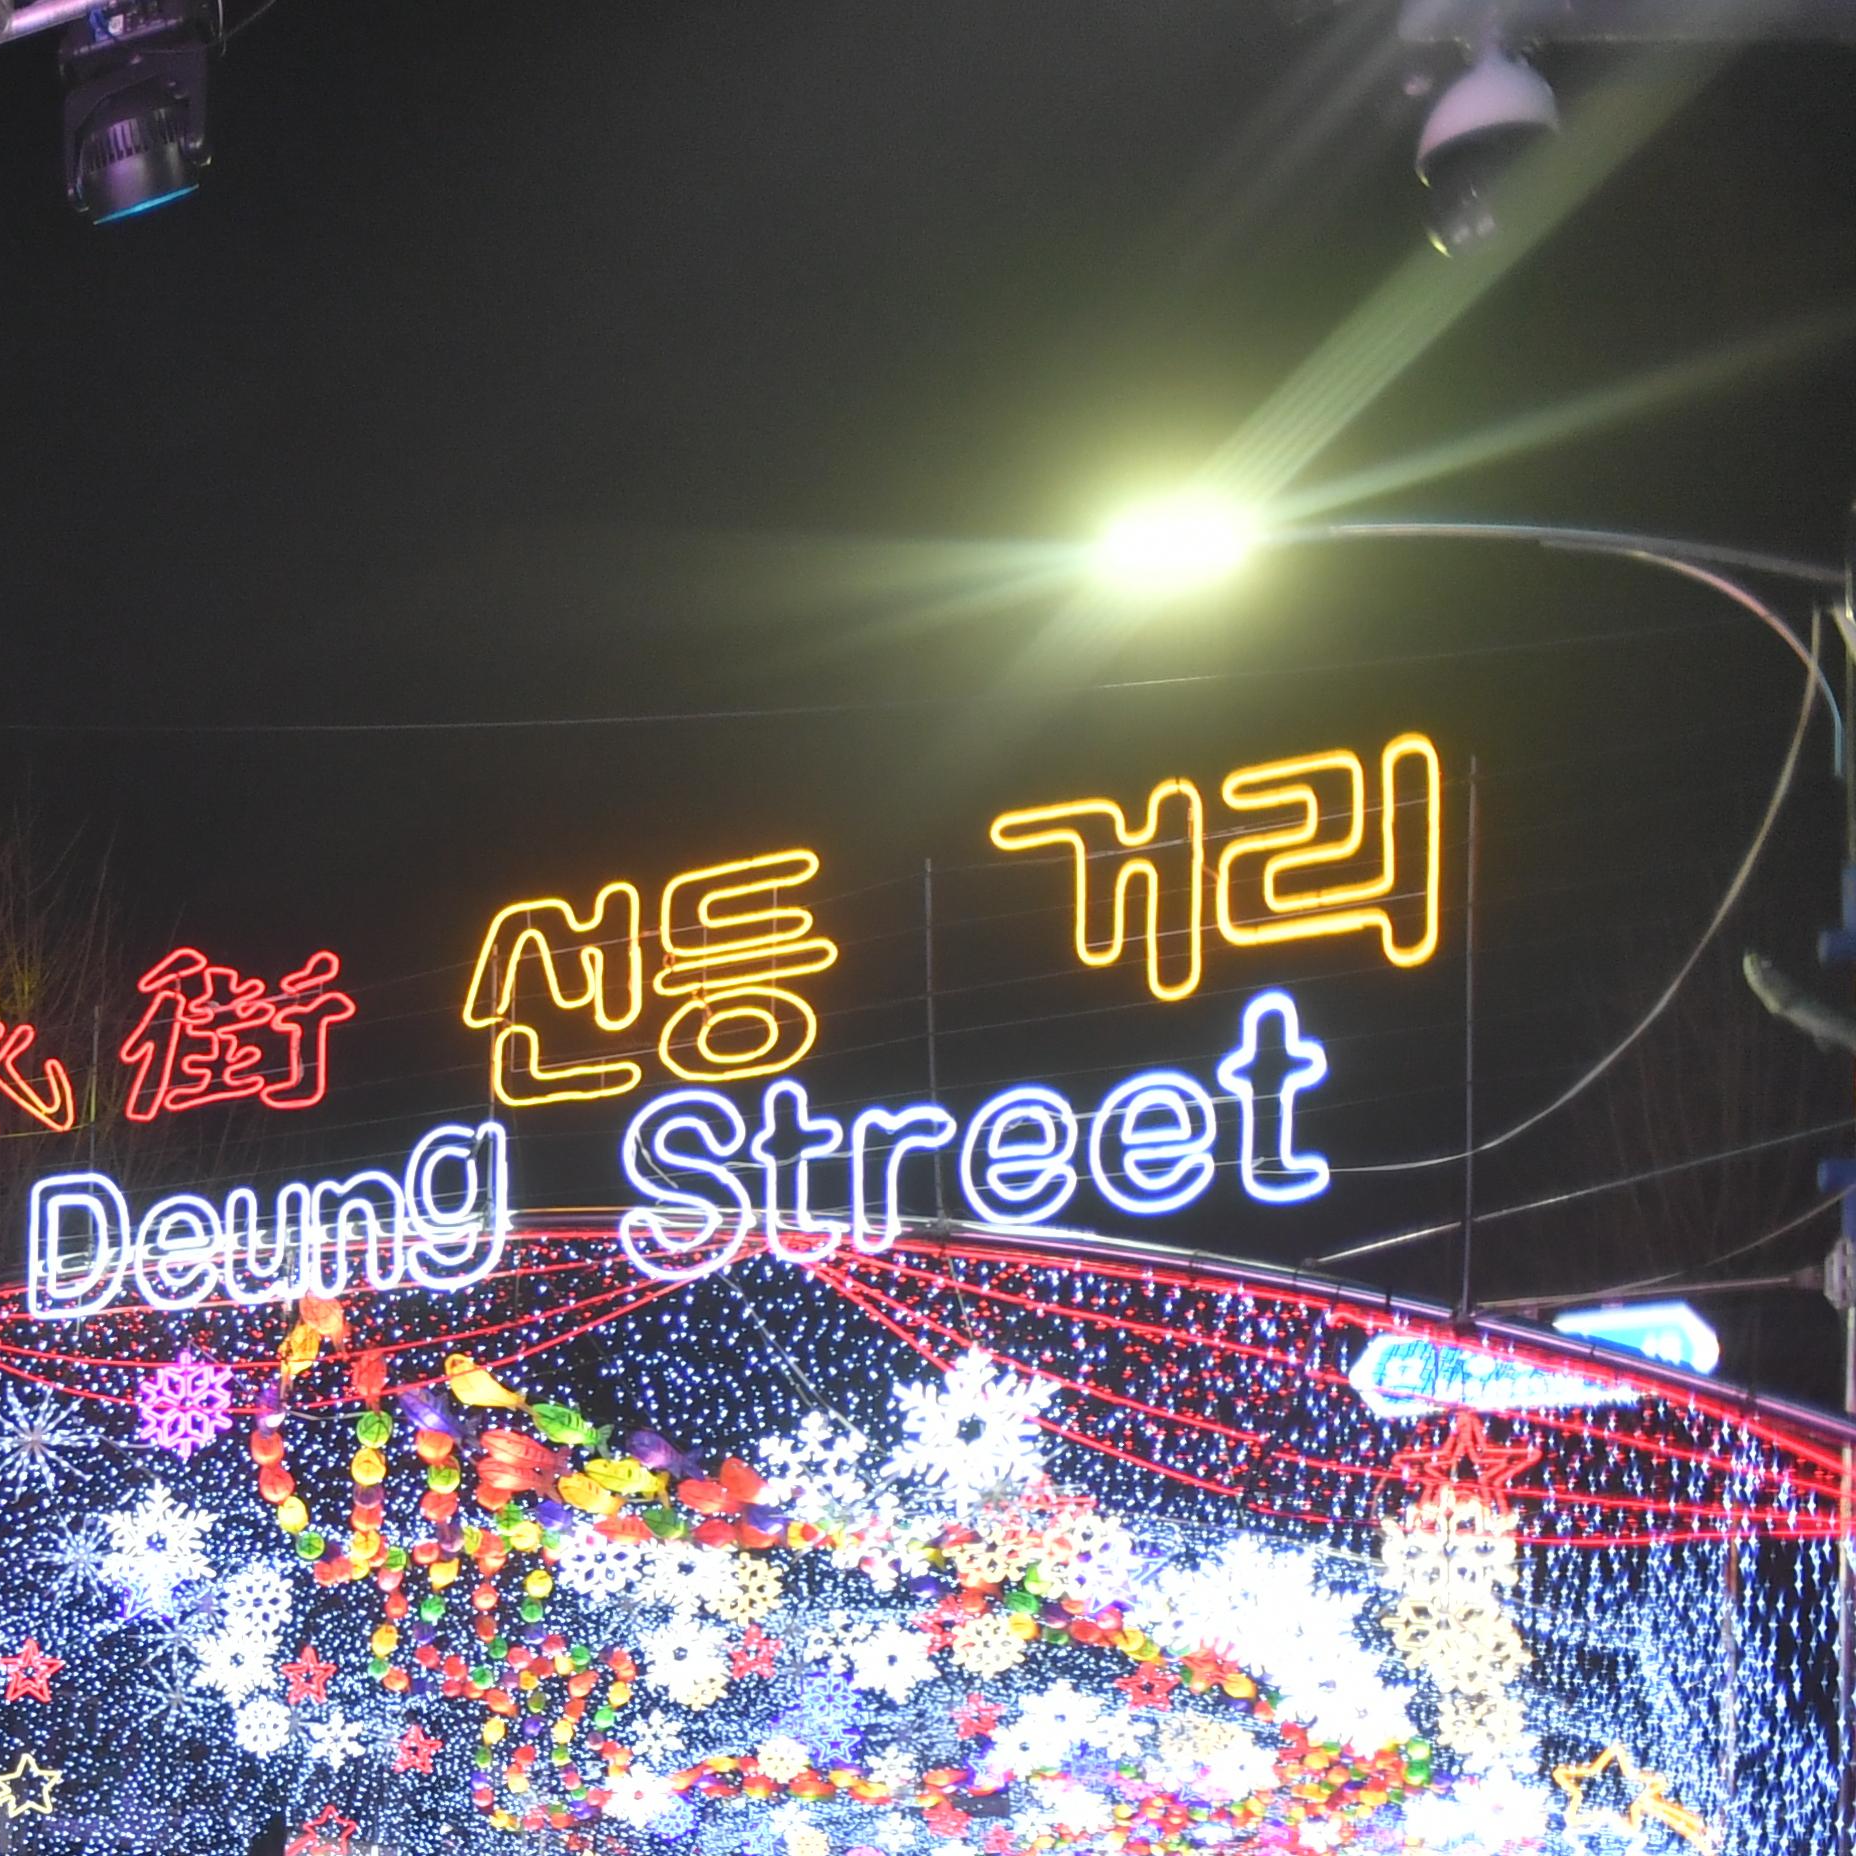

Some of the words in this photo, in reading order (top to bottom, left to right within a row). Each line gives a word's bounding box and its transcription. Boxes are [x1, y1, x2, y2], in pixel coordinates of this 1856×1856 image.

[464, 849, 839, 1107] 선등
[990, 731, 1441, 1002] 거리
[27, 1122, 510, 1322] Deung
[620, 992, 1329, 1279] Street
